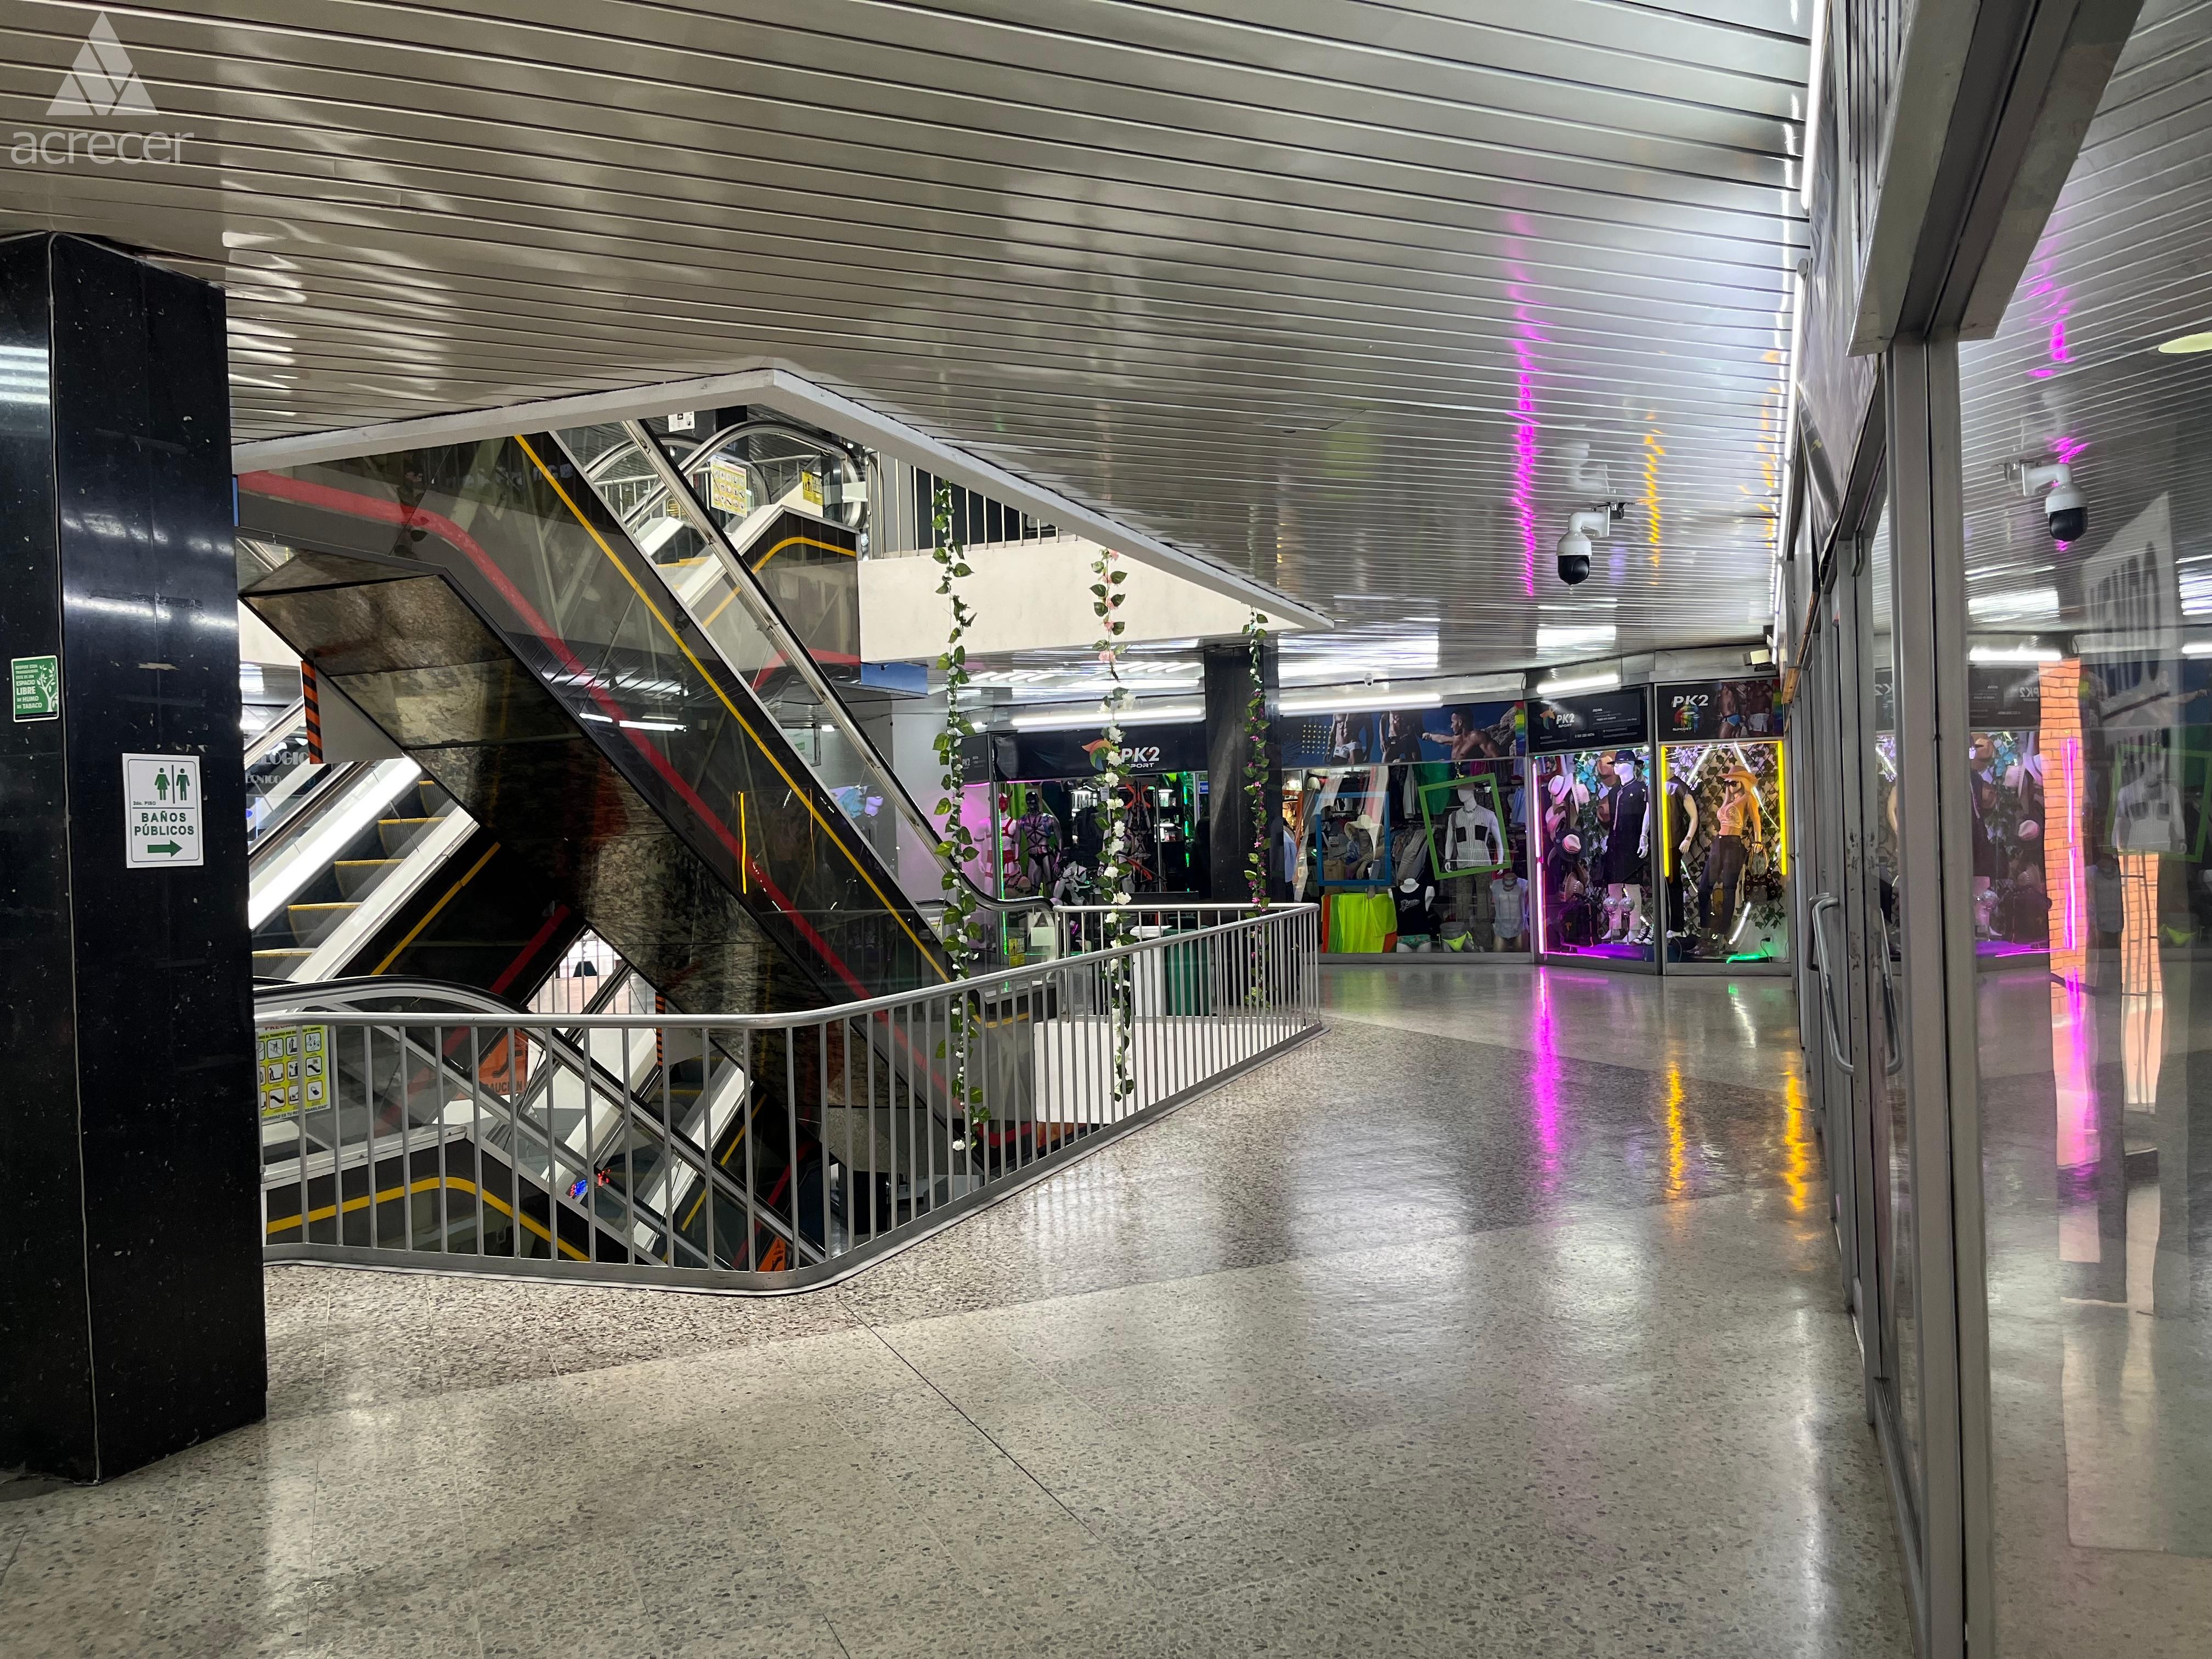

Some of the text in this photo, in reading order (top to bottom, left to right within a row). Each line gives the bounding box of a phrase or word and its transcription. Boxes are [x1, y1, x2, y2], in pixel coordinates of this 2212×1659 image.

[16, 686, 36, 695] LIBRE
[1672, 695, 1709, 708] PK2
[1556, 713, 1575, 724] PK2
[1121, 746, 1160, 763] PK2
[142, 810, 187, 822] BAÑOS
[134, 823, 194, 836] PÚBLICOS
